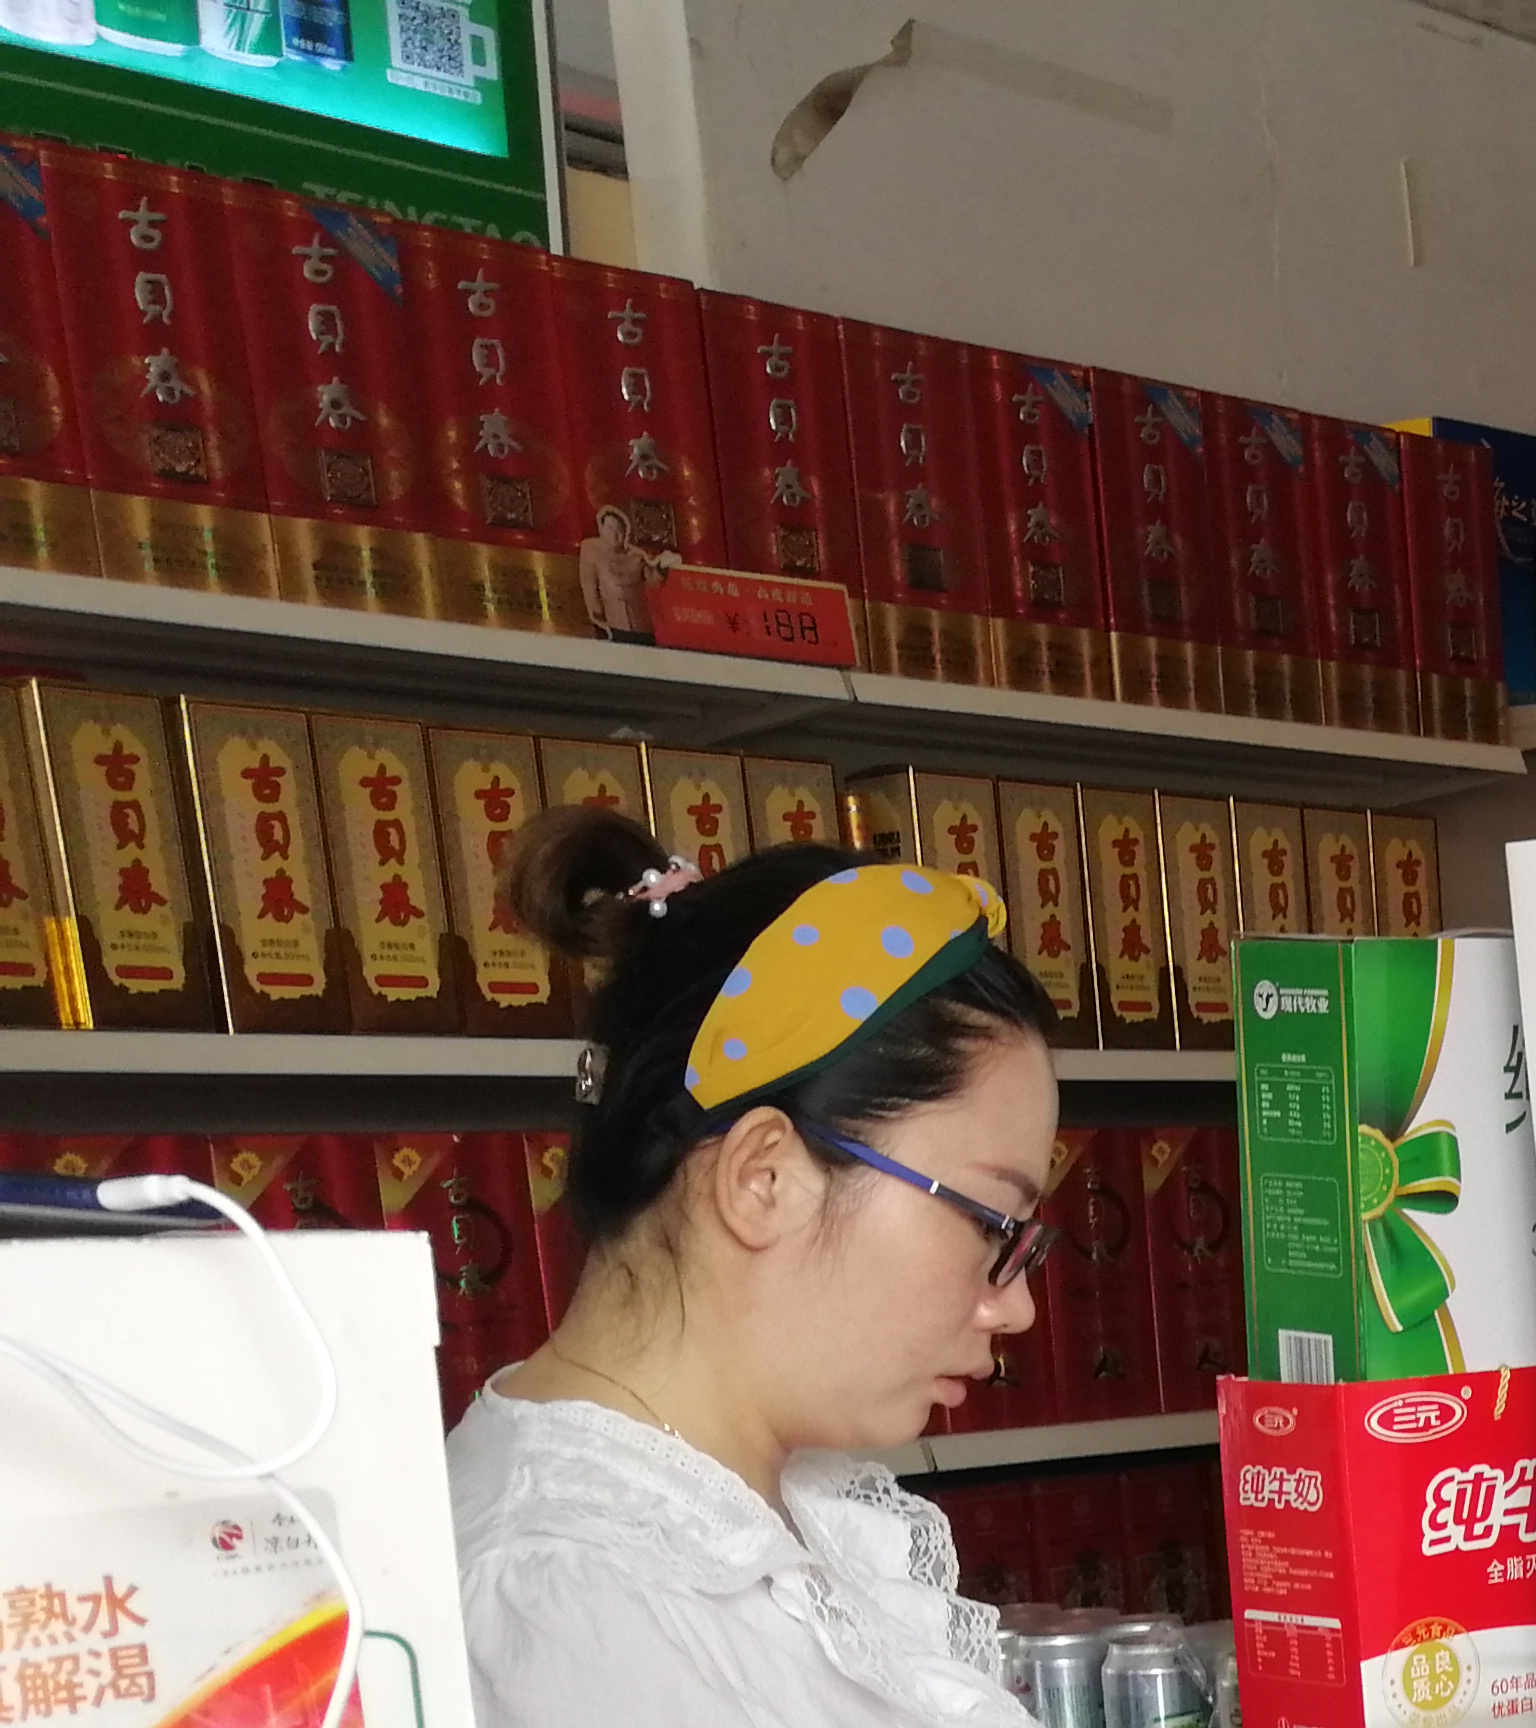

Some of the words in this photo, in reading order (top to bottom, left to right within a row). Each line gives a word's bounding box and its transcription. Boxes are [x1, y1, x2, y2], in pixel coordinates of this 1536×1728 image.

[1260, 838, 1289, 934] 古贝
[1329, 843, 1360, 935] 古贝
[1279, 996, 1330, 1015] 现代牧业
[1392, 1403, 1442, 1431] 三元
[1239, 1466, 1324, 1513] 纯牛奶
[4, 1571, 150, 1654] 熟水
